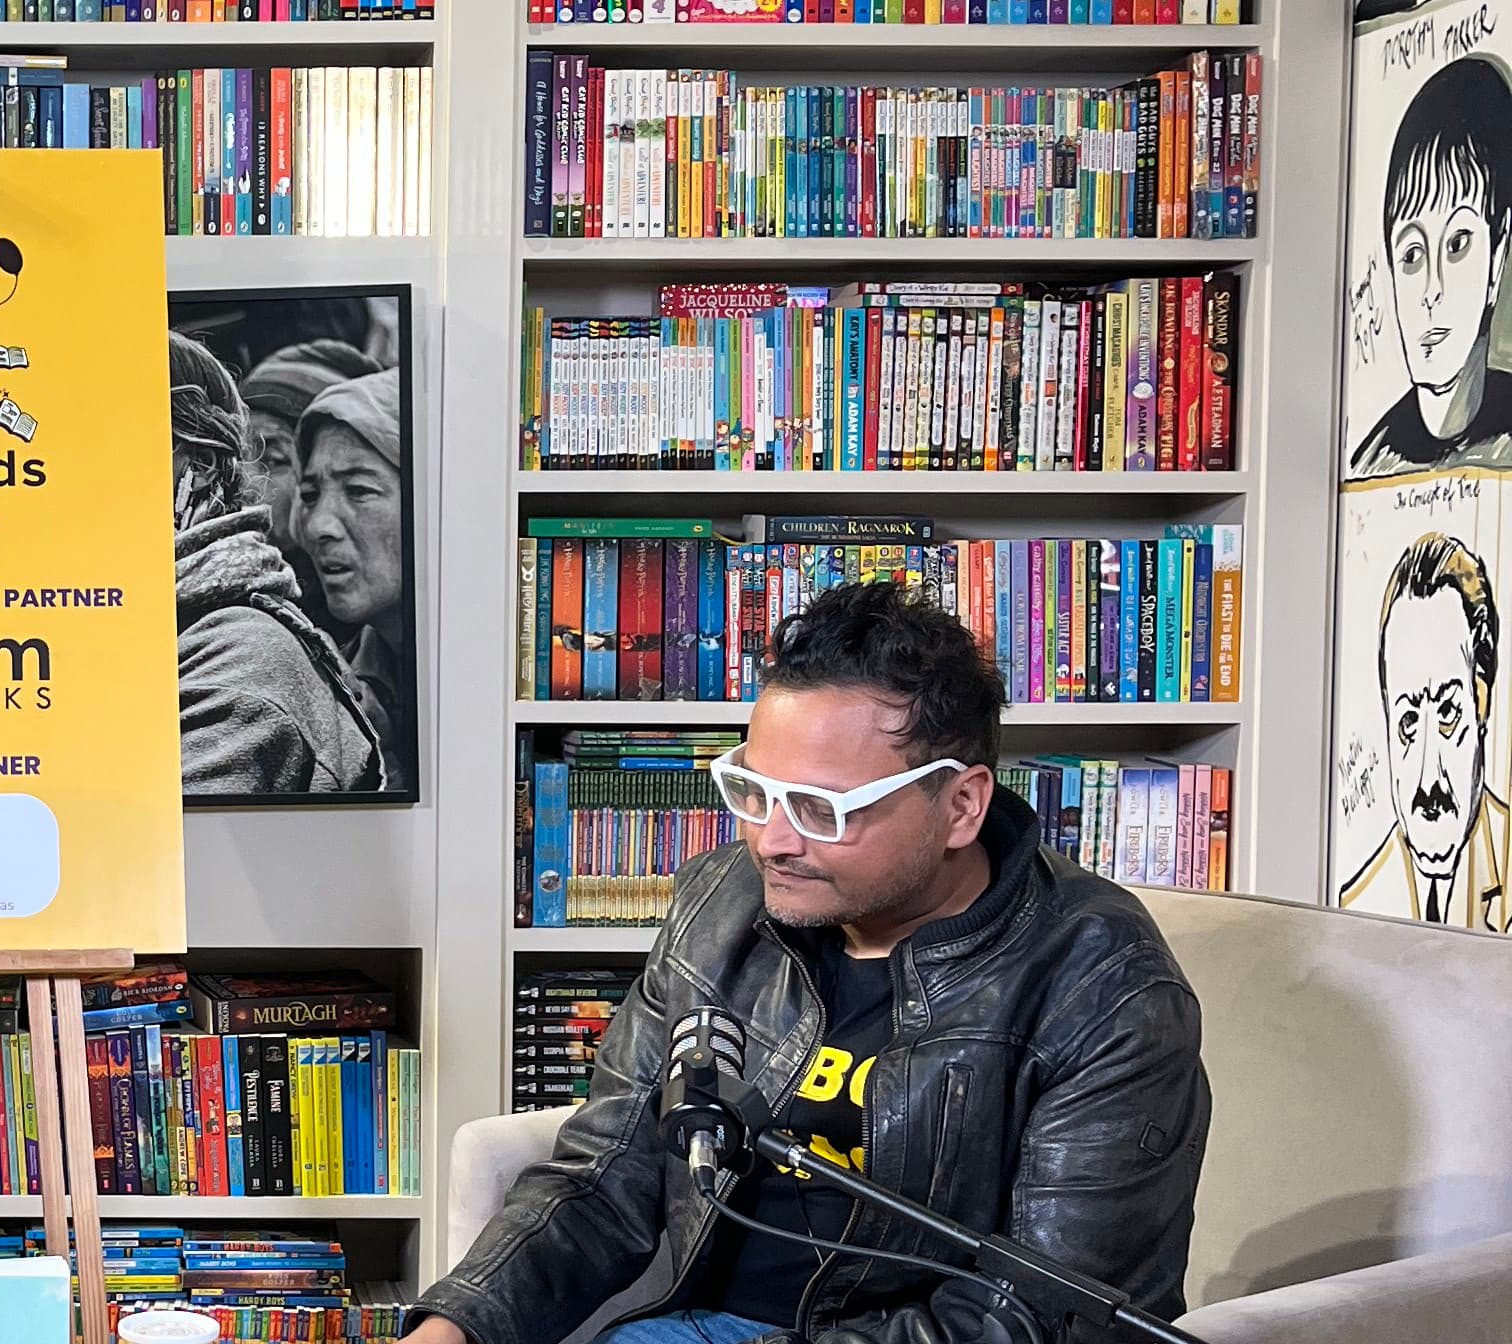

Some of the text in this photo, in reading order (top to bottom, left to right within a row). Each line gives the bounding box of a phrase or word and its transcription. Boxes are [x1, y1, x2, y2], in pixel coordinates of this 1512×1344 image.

[258, 134, 266, 176] REASONS
[534, 129, 548, 166] Goddesses
[258, 178, 266, 199] WHY
[528, 186, 545, 206] Dogs
[678, 294, 772, 308] JACQUELINE
[1210, 291, 1230, 448] SKANDAR STEADMAN
[848, 402, 858, 432] ADAM
[848, 434, 858, 456] KAY
[781, 520, 917, 536] CHILDREN RAGNAROK
[1224, 579, 1232, 592] THE
[4, 588, 123, 609] PARTNER
[1222, 593, 1234, 622] FIRST
[1140, 595, 1156, 653] SPACEBOY
[1221, 634, 1233, 651] DIE
[1221, 665, 1232, 686] END
[252, 1000, 337, 1027] MURTAGH
[242, 1069, 260, 1122] PESTILENCE
[266, 1080, 284, 1113] FAMINE
